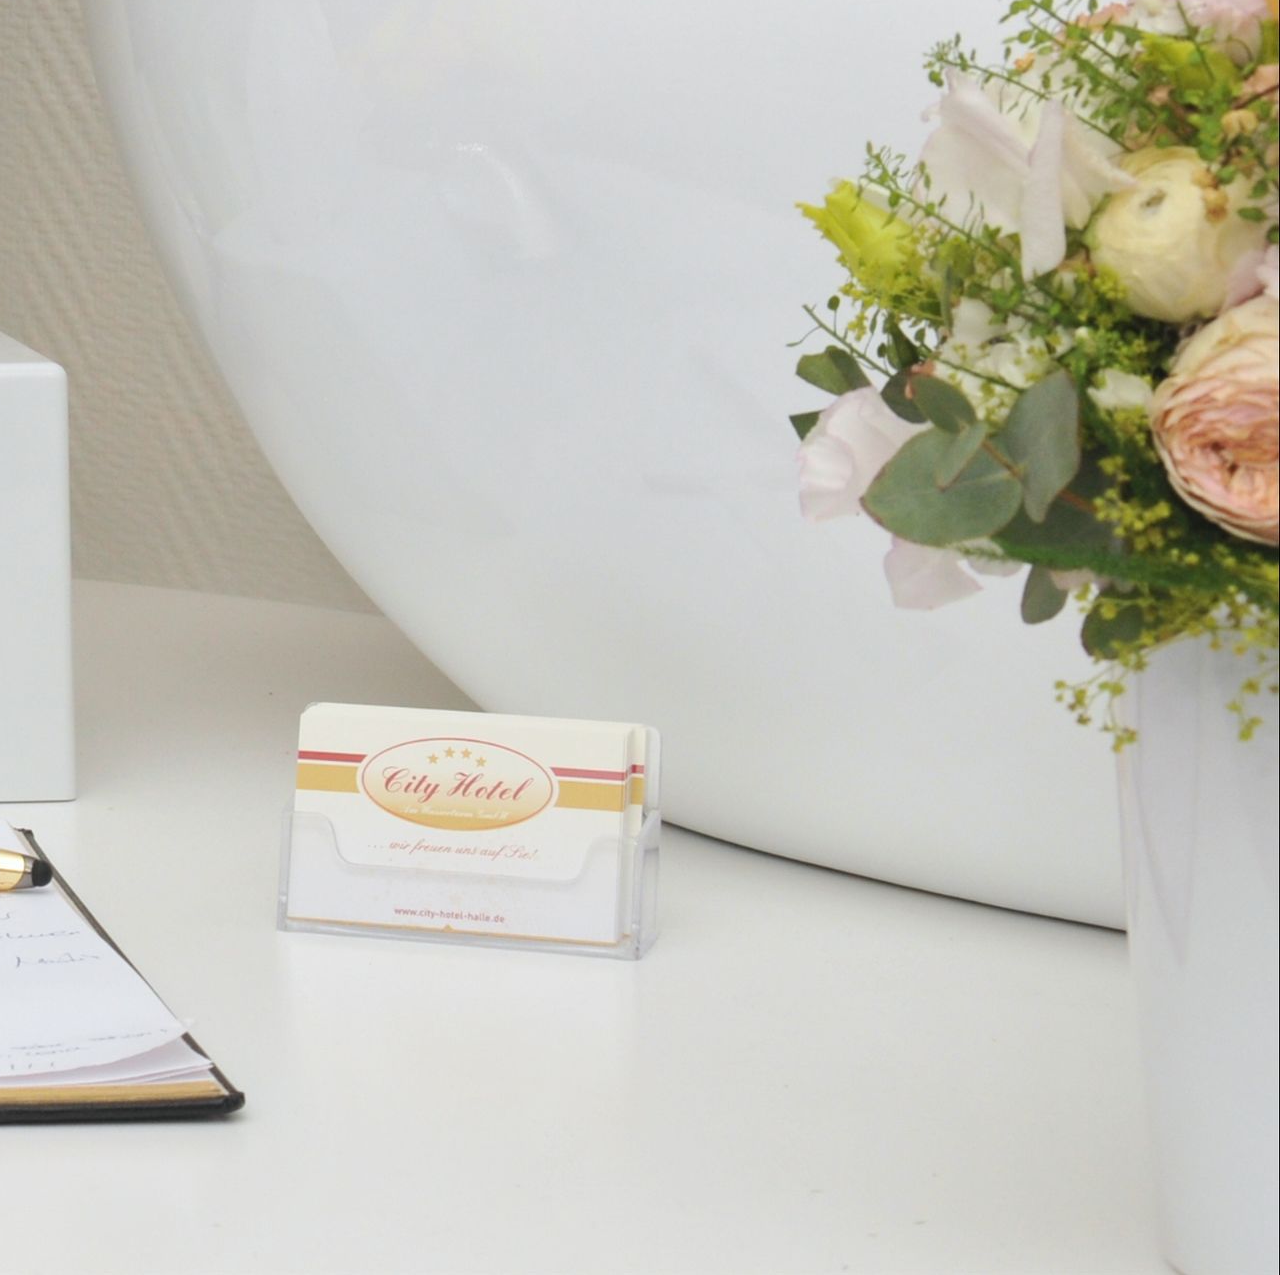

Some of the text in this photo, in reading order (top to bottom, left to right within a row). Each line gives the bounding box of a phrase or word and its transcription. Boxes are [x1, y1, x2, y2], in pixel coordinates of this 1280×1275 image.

[382, 766, 535, 803] City Hotel
[389, 839, 412, 851] wir
[409, 838, 452, 855] freuen
[454, 847, 477, 856] uns
[479, 845, 507, 861] auf
[393, 907, 506, 924] www.city-hotel-halle.de
